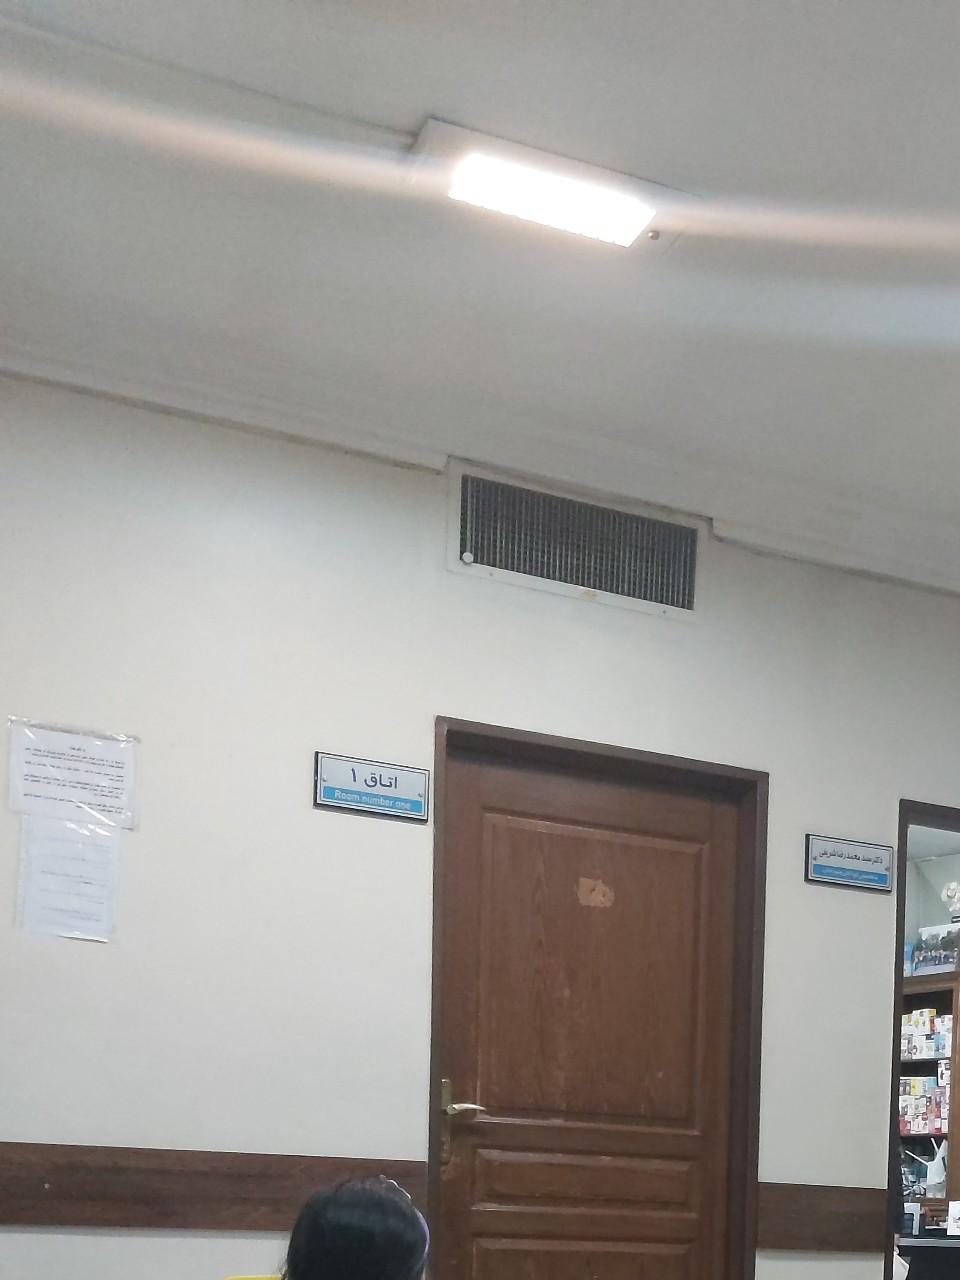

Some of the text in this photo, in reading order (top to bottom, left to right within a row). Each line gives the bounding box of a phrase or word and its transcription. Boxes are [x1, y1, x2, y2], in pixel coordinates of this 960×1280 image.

[364, 771, 398, 789] اتاق
[334, 789, 360, 802] Room
[362, 794, 394, 808] number
